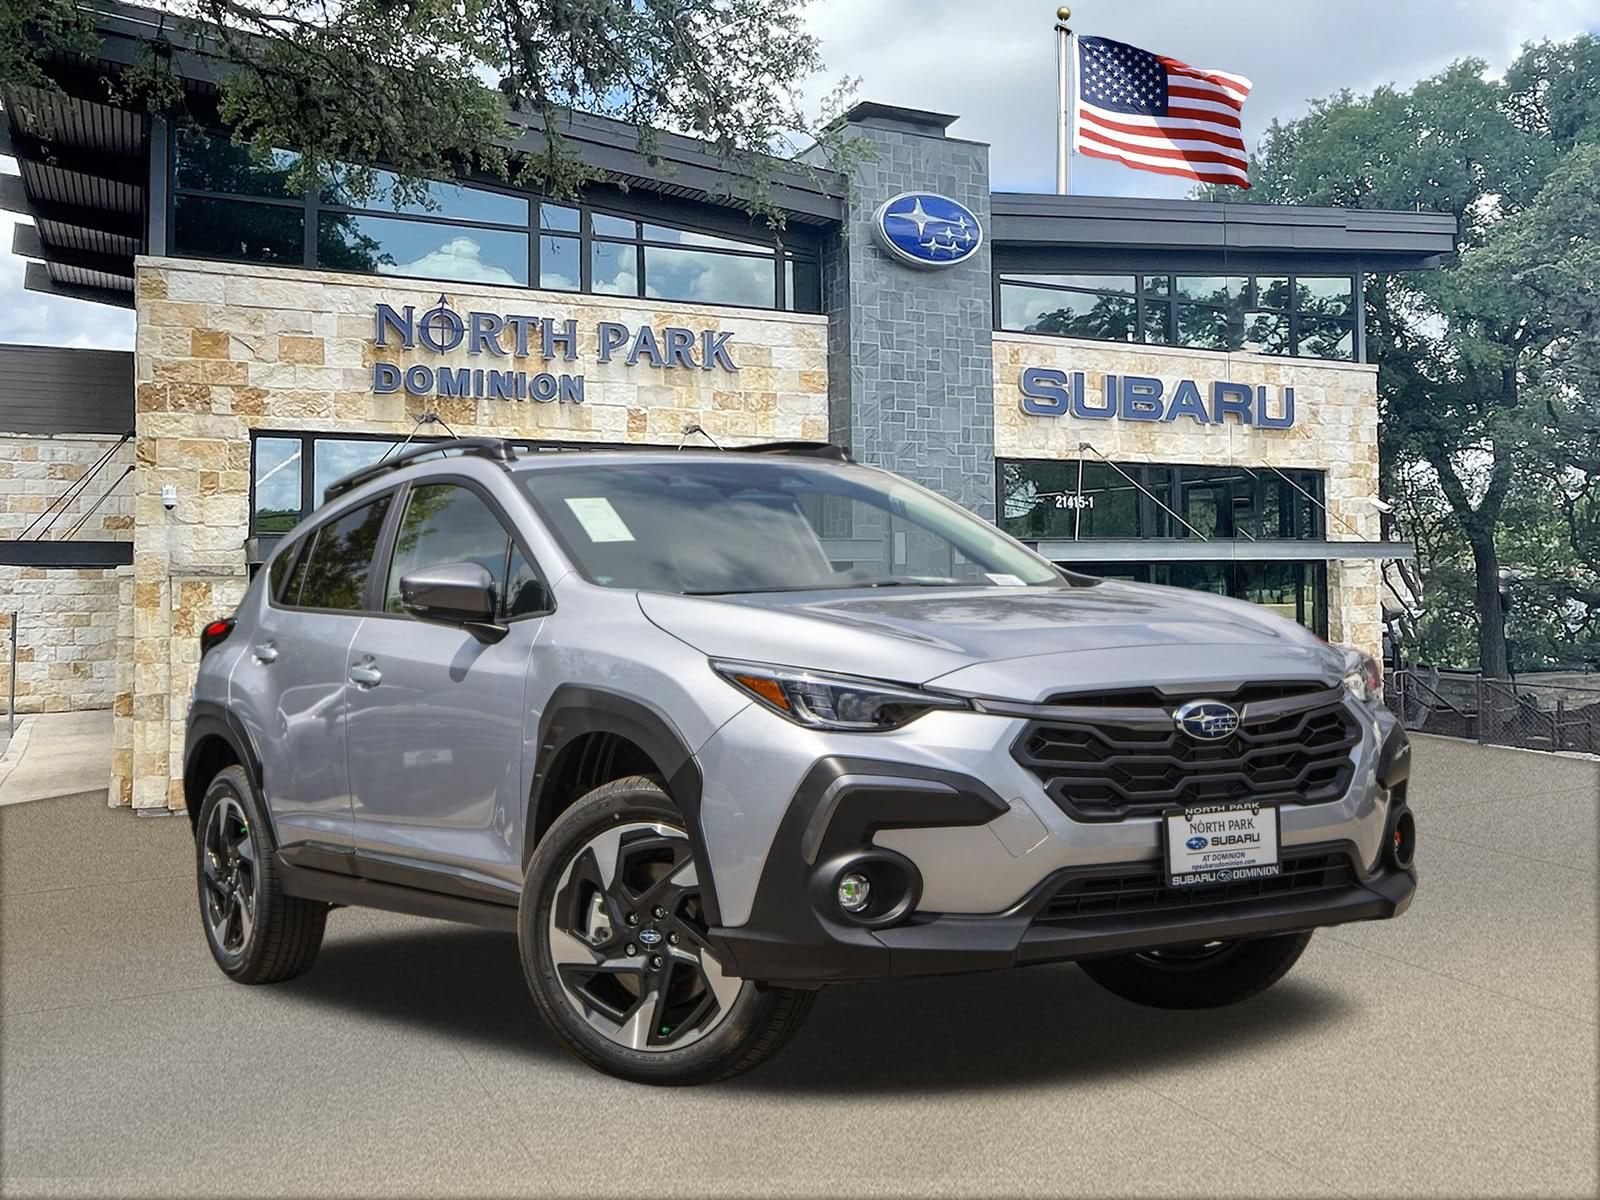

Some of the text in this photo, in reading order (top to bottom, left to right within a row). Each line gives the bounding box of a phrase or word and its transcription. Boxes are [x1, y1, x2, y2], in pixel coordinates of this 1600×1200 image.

[375, 293, 740, 373] NORTH PARK
[374, 362, 584, 403] DOMINION
[1019, 367, 1295, 430] SUBARU
[1185, 802, 1260, 815] NORTH PARK
[1189, 818, 1255, 834] NORTH PARK
[1211, 833, 1260, 846] SUBARU
[1212, 852, 1246, 861] DOMINION
[1172, 865, 1280, 886] SUBARU DOMINION
